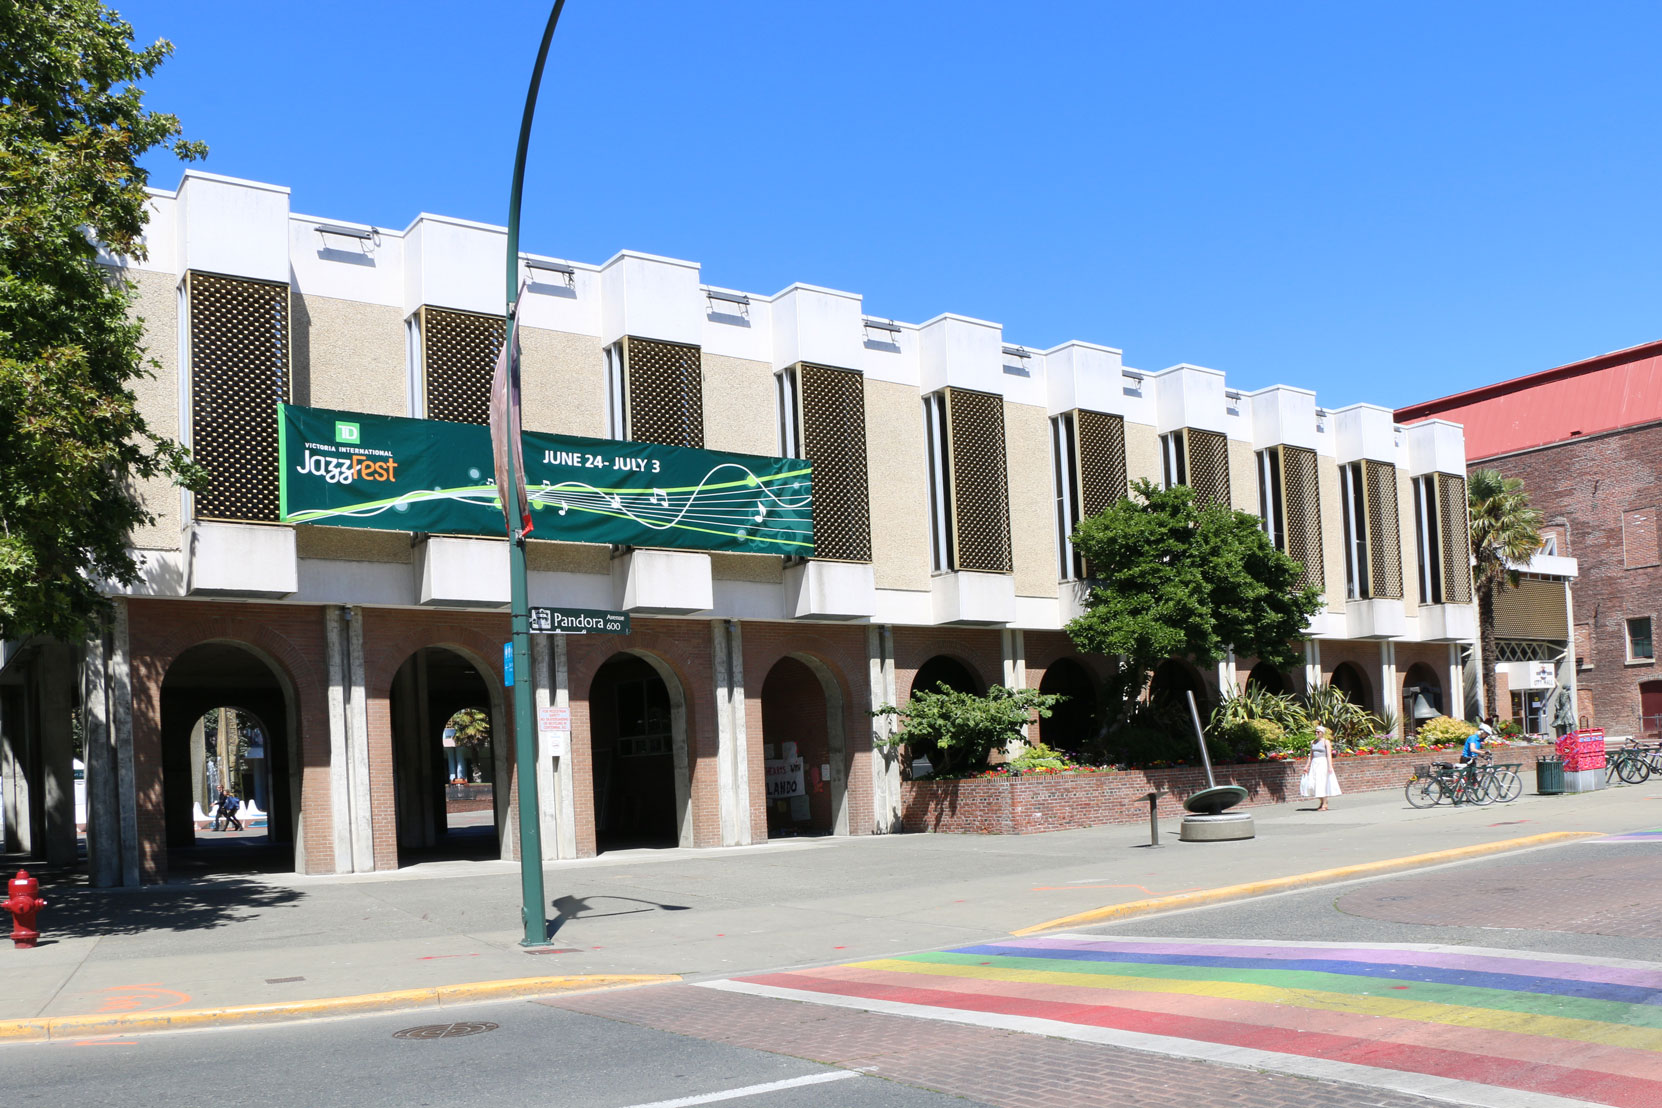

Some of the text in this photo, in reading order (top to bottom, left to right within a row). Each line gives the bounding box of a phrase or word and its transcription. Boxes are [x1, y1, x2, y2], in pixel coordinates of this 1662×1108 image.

[337, 425, 358, 440] TD
[304, 442, 393, 457] VICTORIA INTERNATIONAL
[296, 450, 399, 485] JazzFest
[543, 449, 582, 467] JUNE
[613, 456, 648, 472] JULY
[651, 459, 661, 473] 3
[554, 613, 604, 629] Pandora
[606, 622, 621, 631] 600
